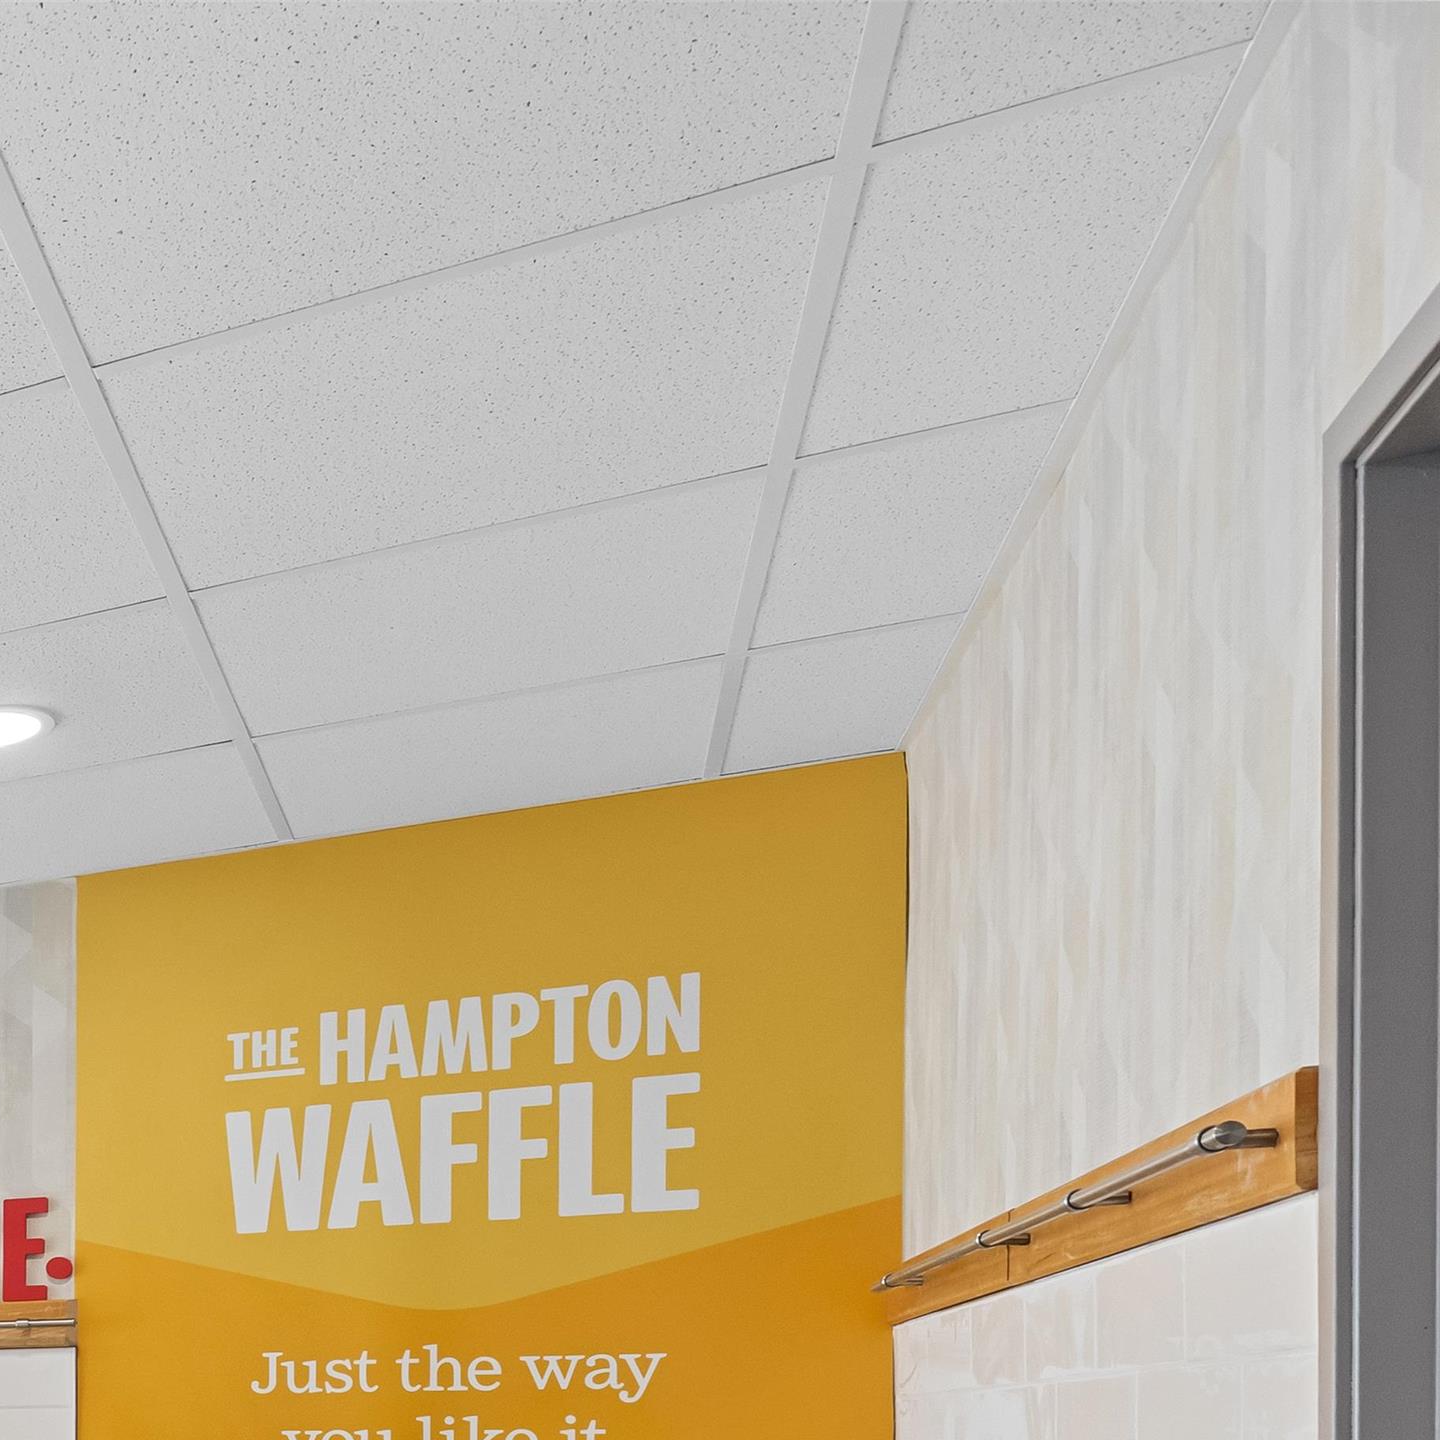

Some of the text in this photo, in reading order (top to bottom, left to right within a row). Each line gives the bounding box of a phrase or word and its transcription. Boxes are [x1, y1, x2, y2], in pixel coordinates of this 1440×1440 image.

[225, 972, 701, 1086] THE HAMPTON
[225, 1072, 701, 1235] WAFFLE
[250, 1344, 668, 1404] Just the way
